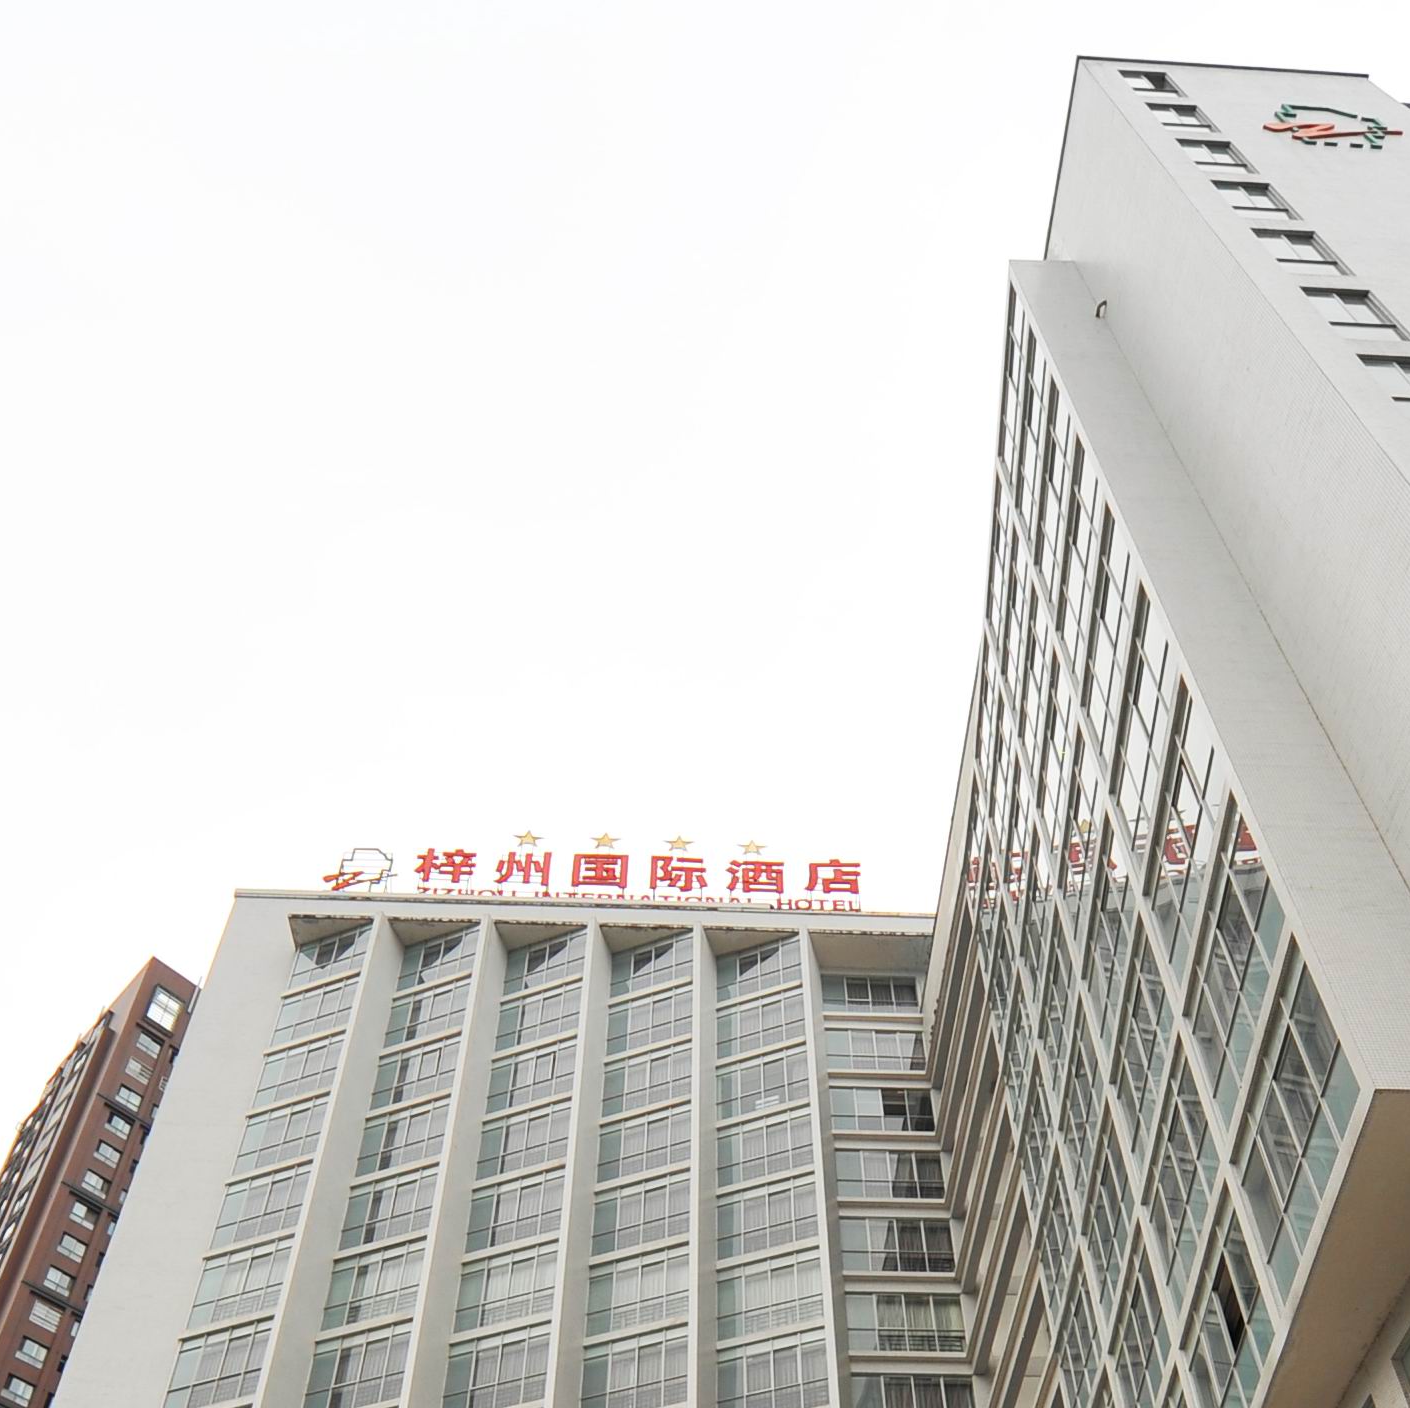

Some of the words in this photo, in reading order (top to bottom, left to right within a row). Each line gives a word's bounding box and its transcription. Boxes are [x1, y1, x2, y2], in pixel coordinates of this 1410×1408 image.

[413, 847, 862, 895] 梓州国际酒店
[777, 898, 862, 912] HOTEL
